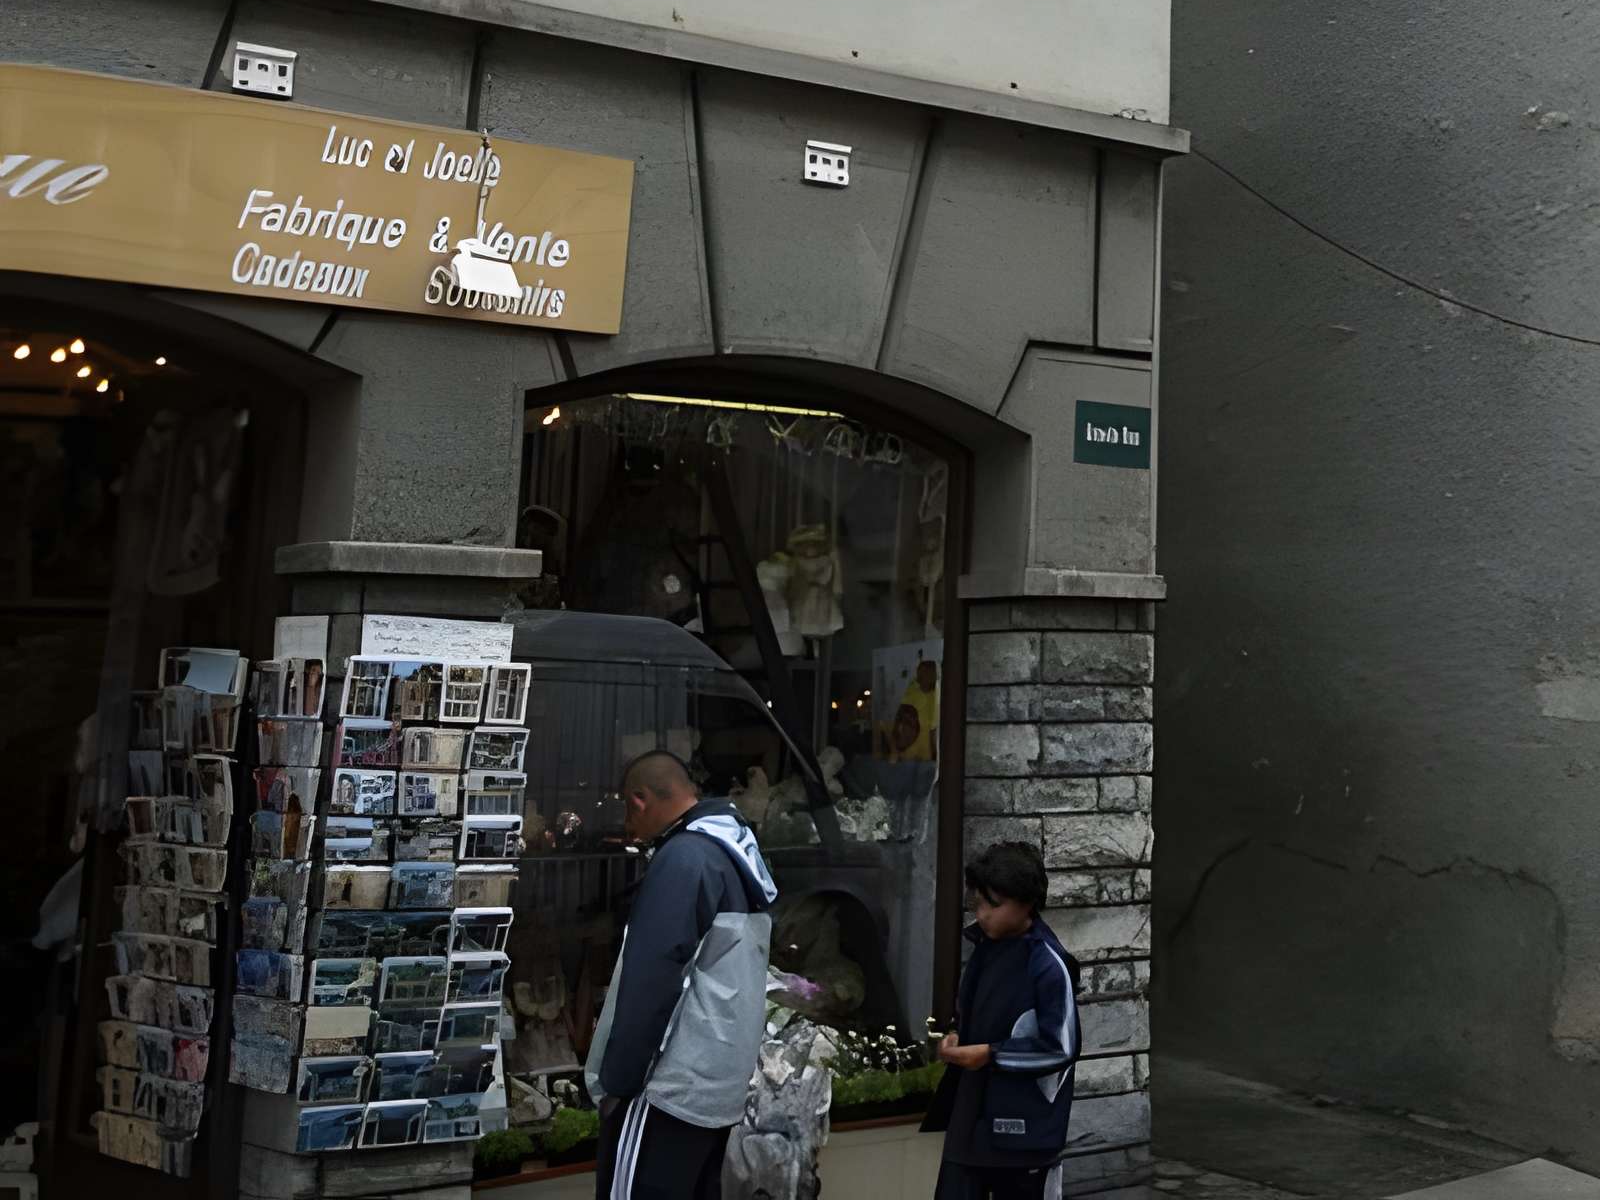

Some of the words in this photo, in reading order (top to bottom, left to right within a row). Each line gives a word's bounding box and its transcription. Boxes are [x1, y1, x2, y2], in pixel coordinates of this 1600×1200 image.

[237, 189, 408, 252] Fabrique
[429, 216, 451, 253] &
[231, 242, 370, 298] Cadeaux
